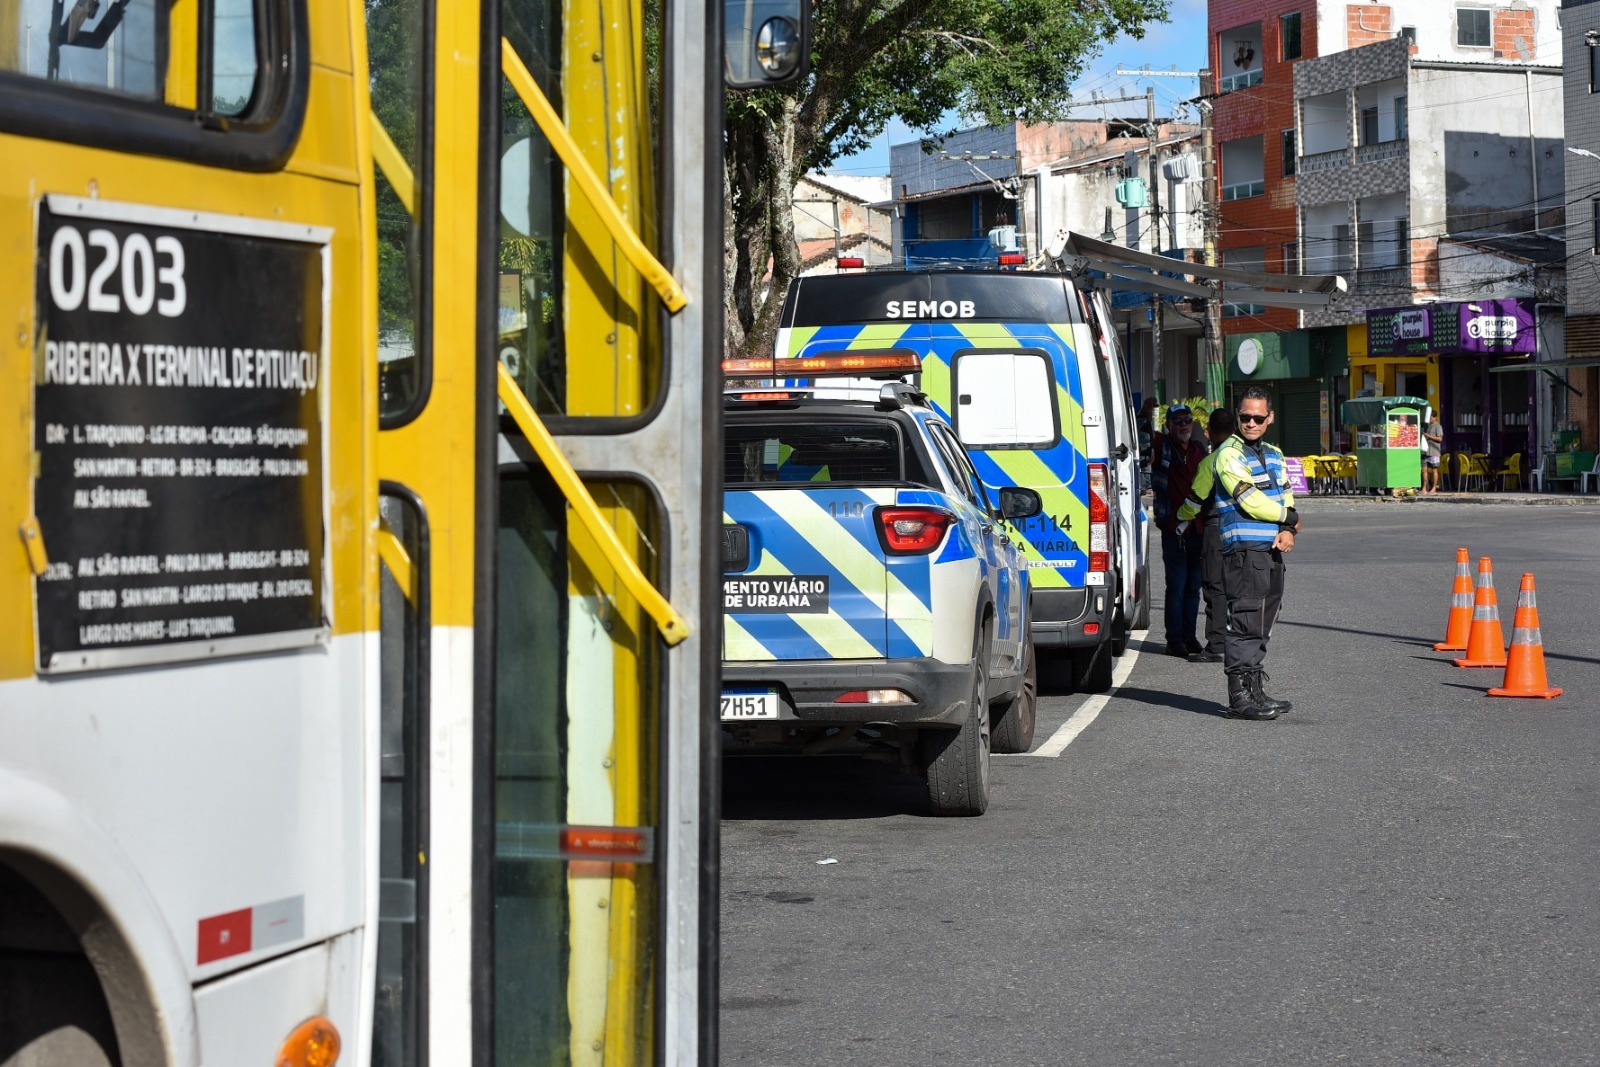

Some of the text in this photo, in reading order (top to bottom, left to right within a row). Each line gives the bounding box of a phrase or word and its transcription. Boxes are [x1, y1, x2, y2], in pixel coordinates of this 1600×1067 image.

[49, 225, 187, 318] 0203
[886, 300, 976, 318] SEMOB
[1485, 319, 1514, 327] purple
[1485, 329, 1512, 337] house
[45, 340, 317, 397] RIBEIRA X TERMINAL DE PITUAÇU
[1031, 538, 1080, 553] VIÁRIA
[773, 577, 825, 594] VIÁRIO
[747, 594, 811, 607] URBANA
[721, 697, 767, 716] 7H51
